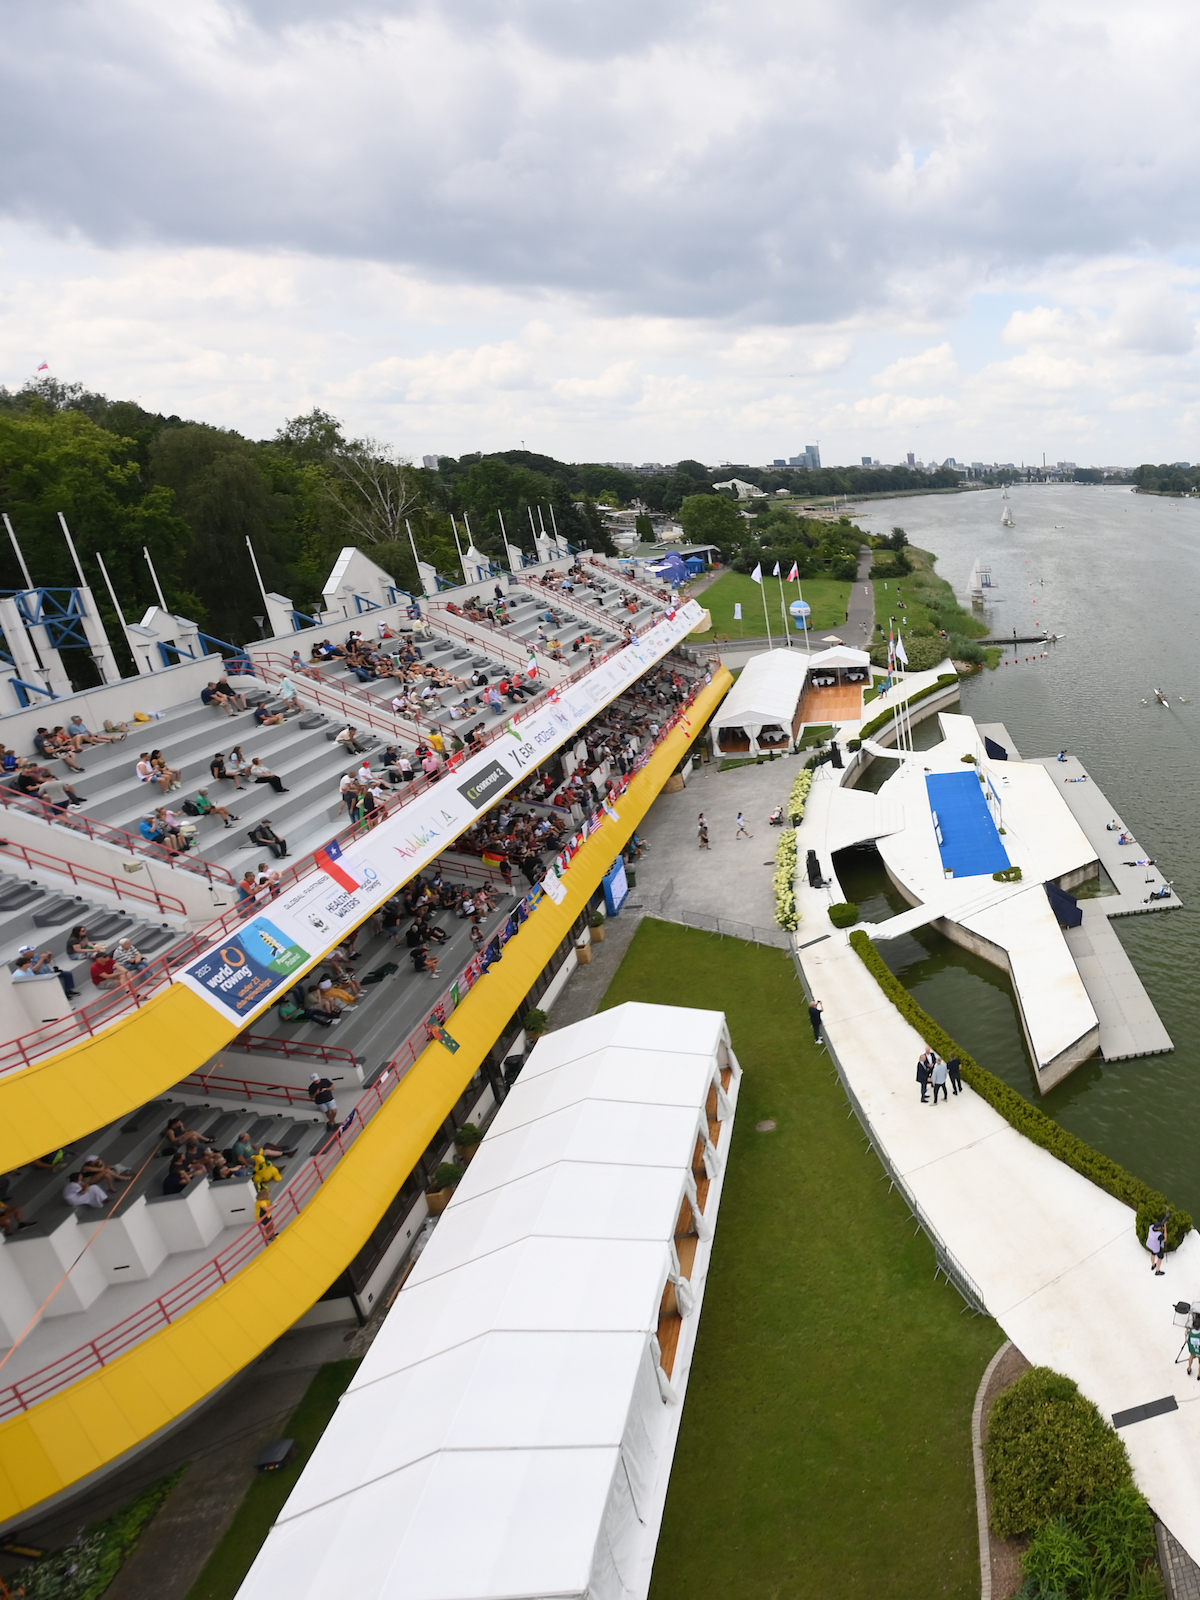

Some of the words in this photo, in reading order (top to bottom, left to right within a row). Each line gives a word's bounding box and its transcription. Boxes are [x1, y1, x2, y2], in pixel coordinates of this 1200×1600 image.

[519, 742, 536, 759] EXR
[283, 893, 306, 910] GLOBAL
[325, 891, 353, 913] HEALTHY
[335, 897, 361, 918] WATERS
[194, 964, 212, 978] 2025
[206, 963, 234, 988] world
[219, 964, 253, 992] rowing
